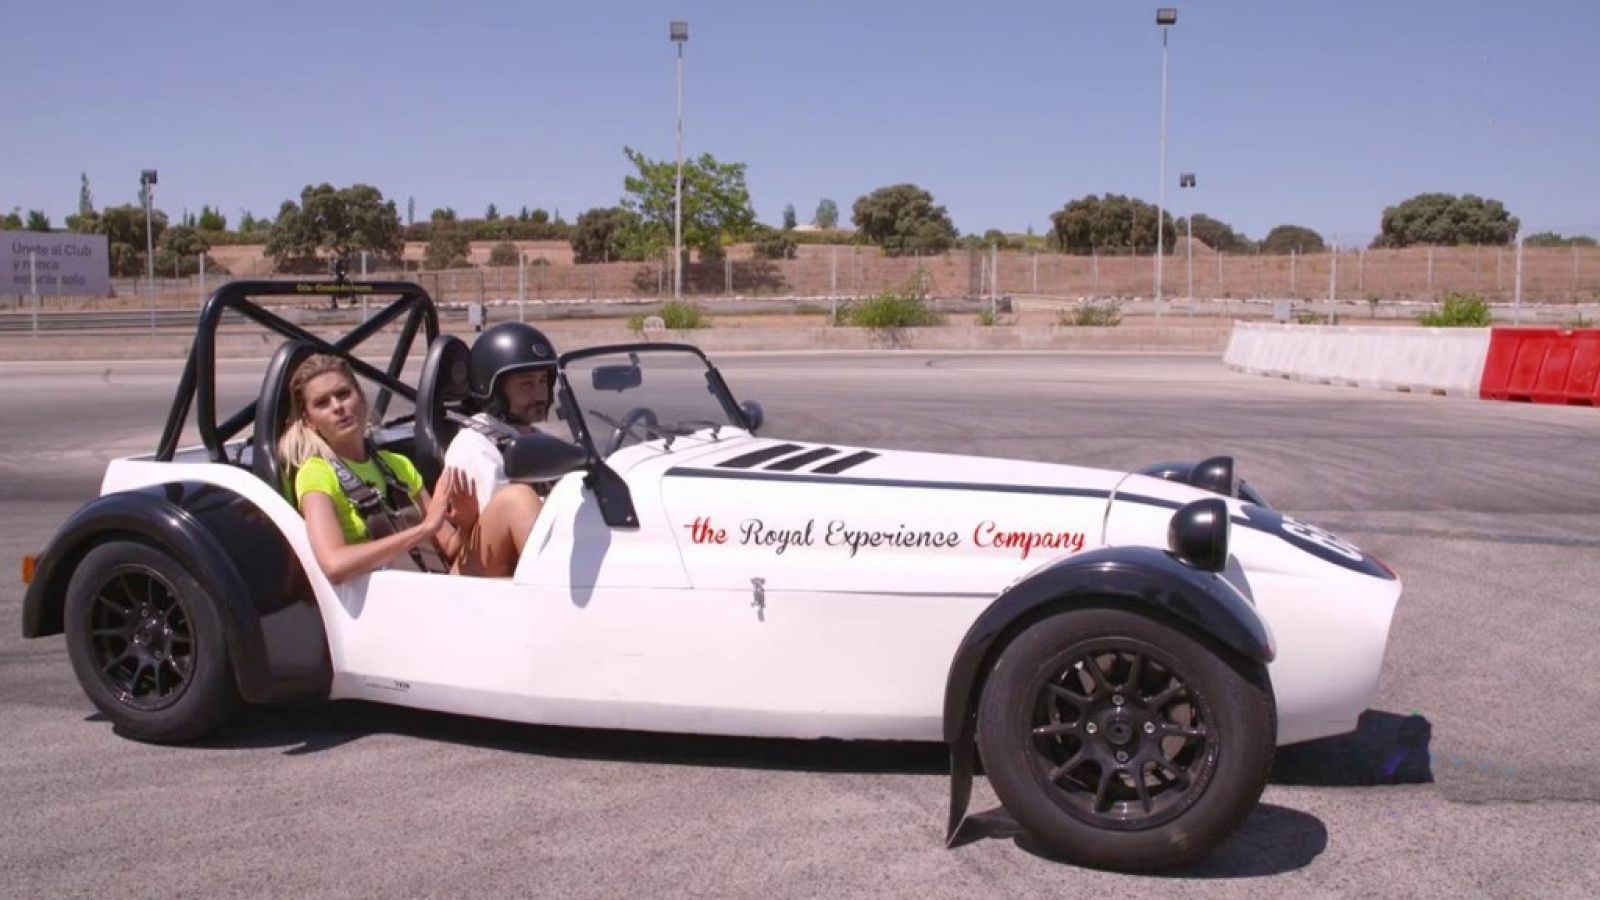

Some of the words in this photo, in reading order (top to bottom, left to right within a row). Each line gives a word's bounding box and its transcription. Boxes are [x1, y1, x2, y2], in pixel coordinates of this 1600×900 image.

[51, 244, 63, 257] al
[64, 244, 92, 257] Club
[684, 516, 728, 545] the
[739, 518, 815, 555] Royal
[825, 519, 960, 558] Experience
[973, 520, 1086, 560] Company
